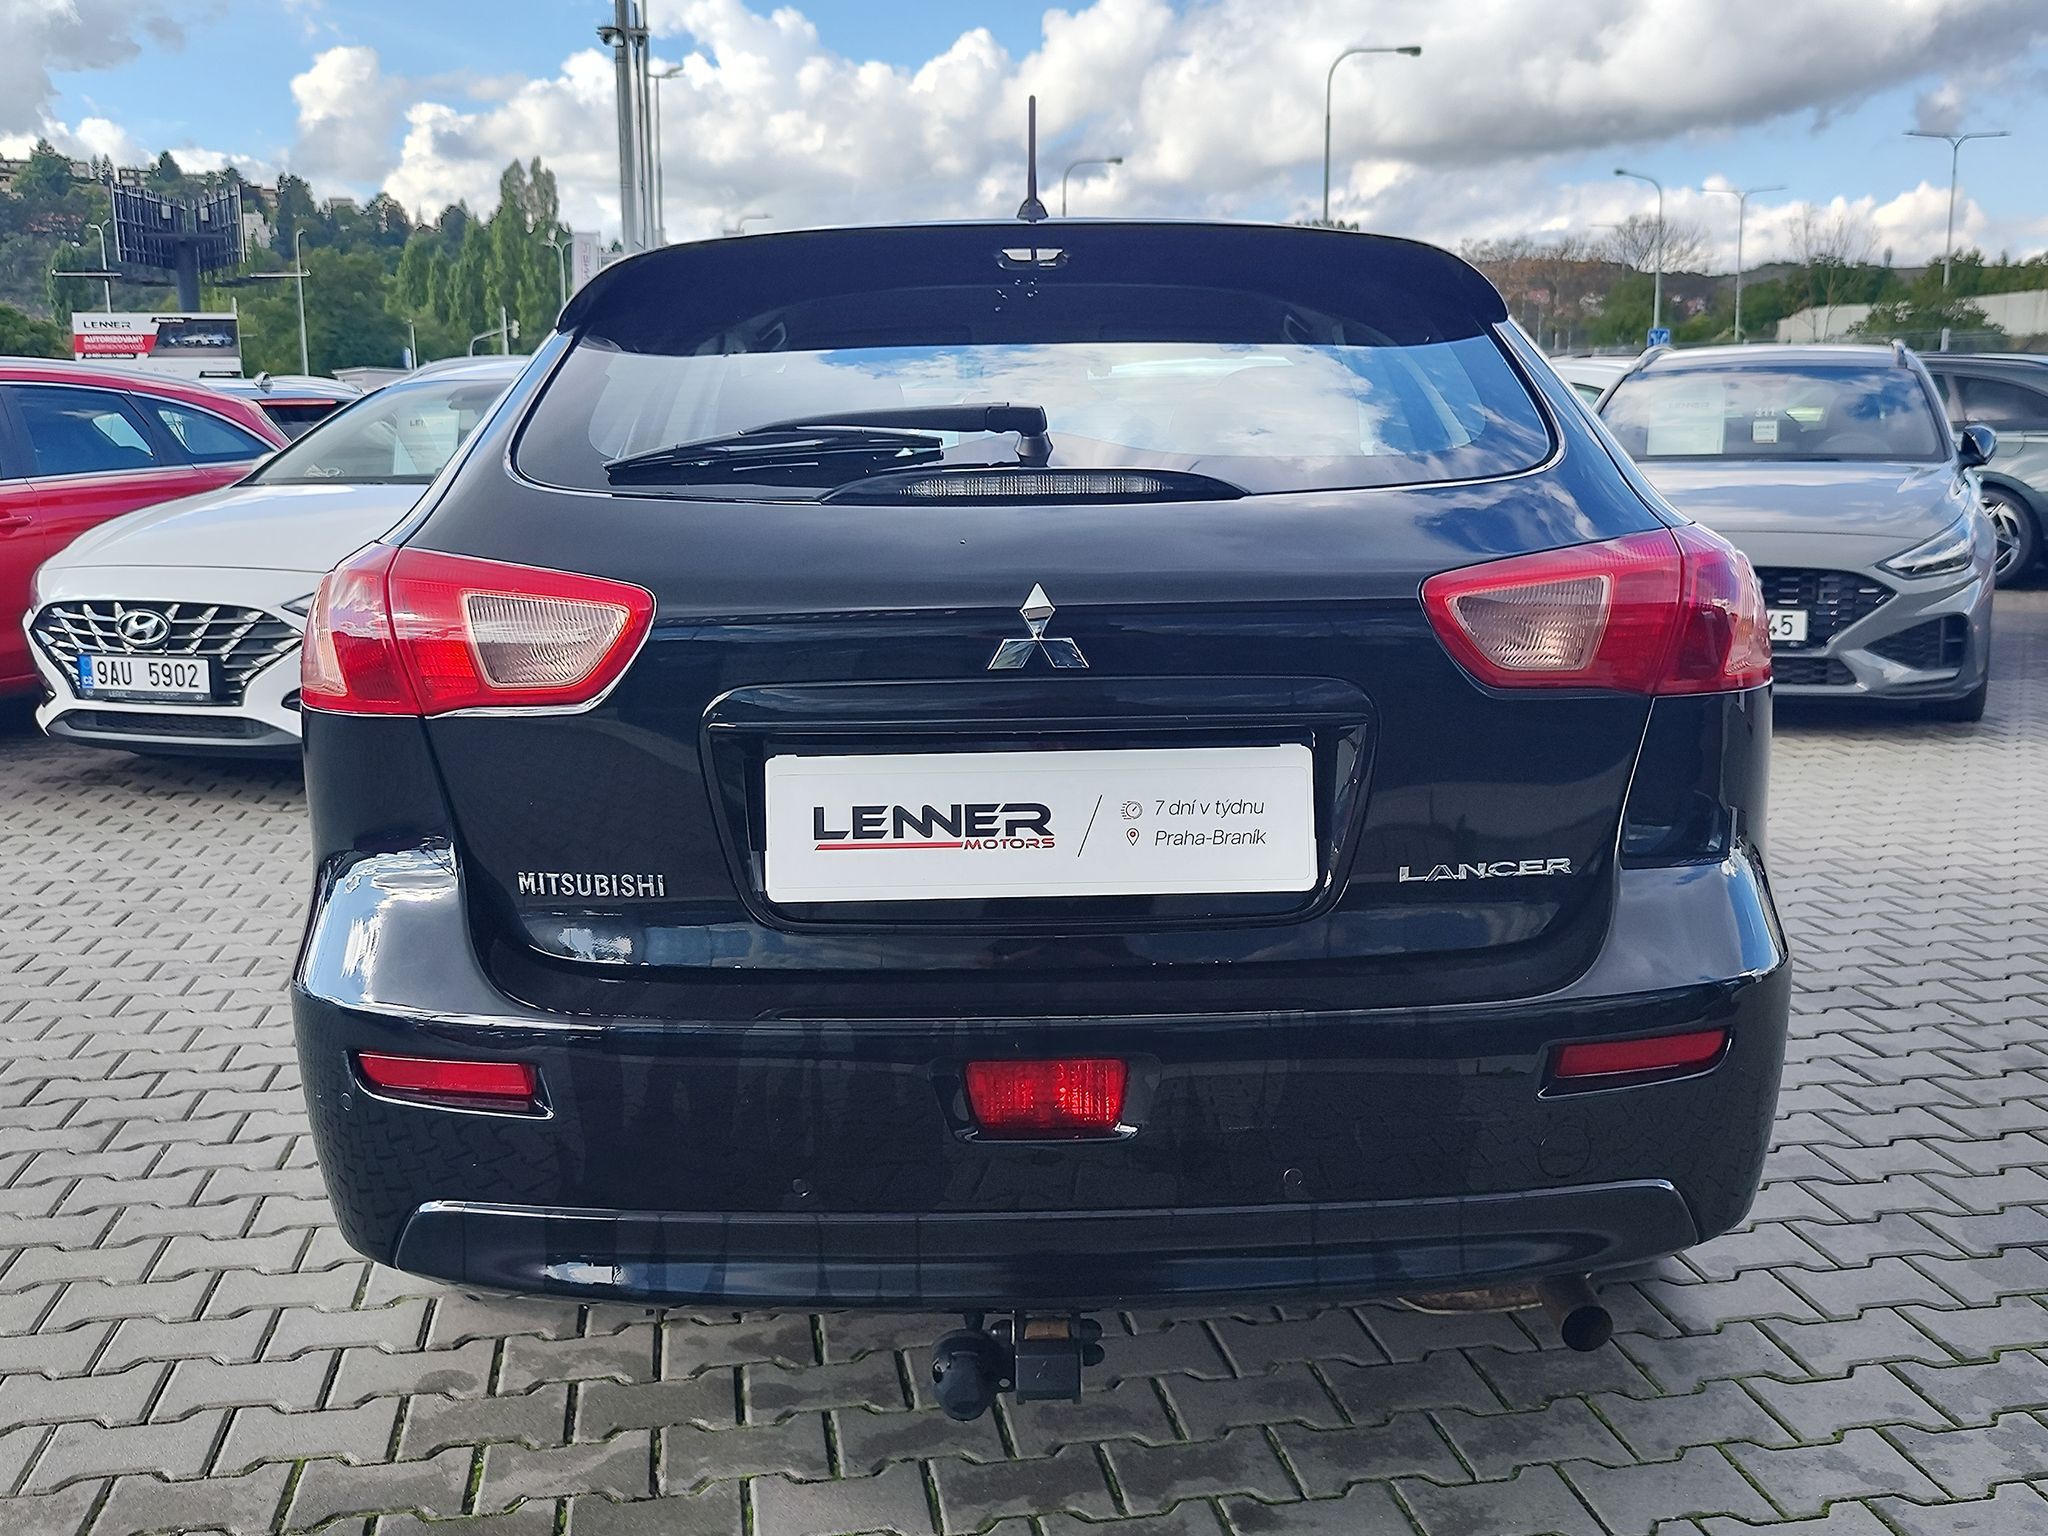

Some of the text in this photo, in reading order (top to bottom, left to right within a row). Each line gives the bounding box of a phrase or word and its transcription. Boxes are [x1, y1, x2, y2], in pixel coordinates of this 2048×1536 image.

[83, 321, 131, 329] LENNER
[97, 661, 199, 688] 9AU 5902
[1155, 798, 1265, 819] 7 dní v týdnu
[813, 803, 1055, 840] LENNER
[964, 838, 1056, 850] MOTORS
[1154, 829, 1267, 846] Praha-Braník
[1399, 857, 1573, 883] LANCER
[517, 871, 666, 898] MITSUBISHI
